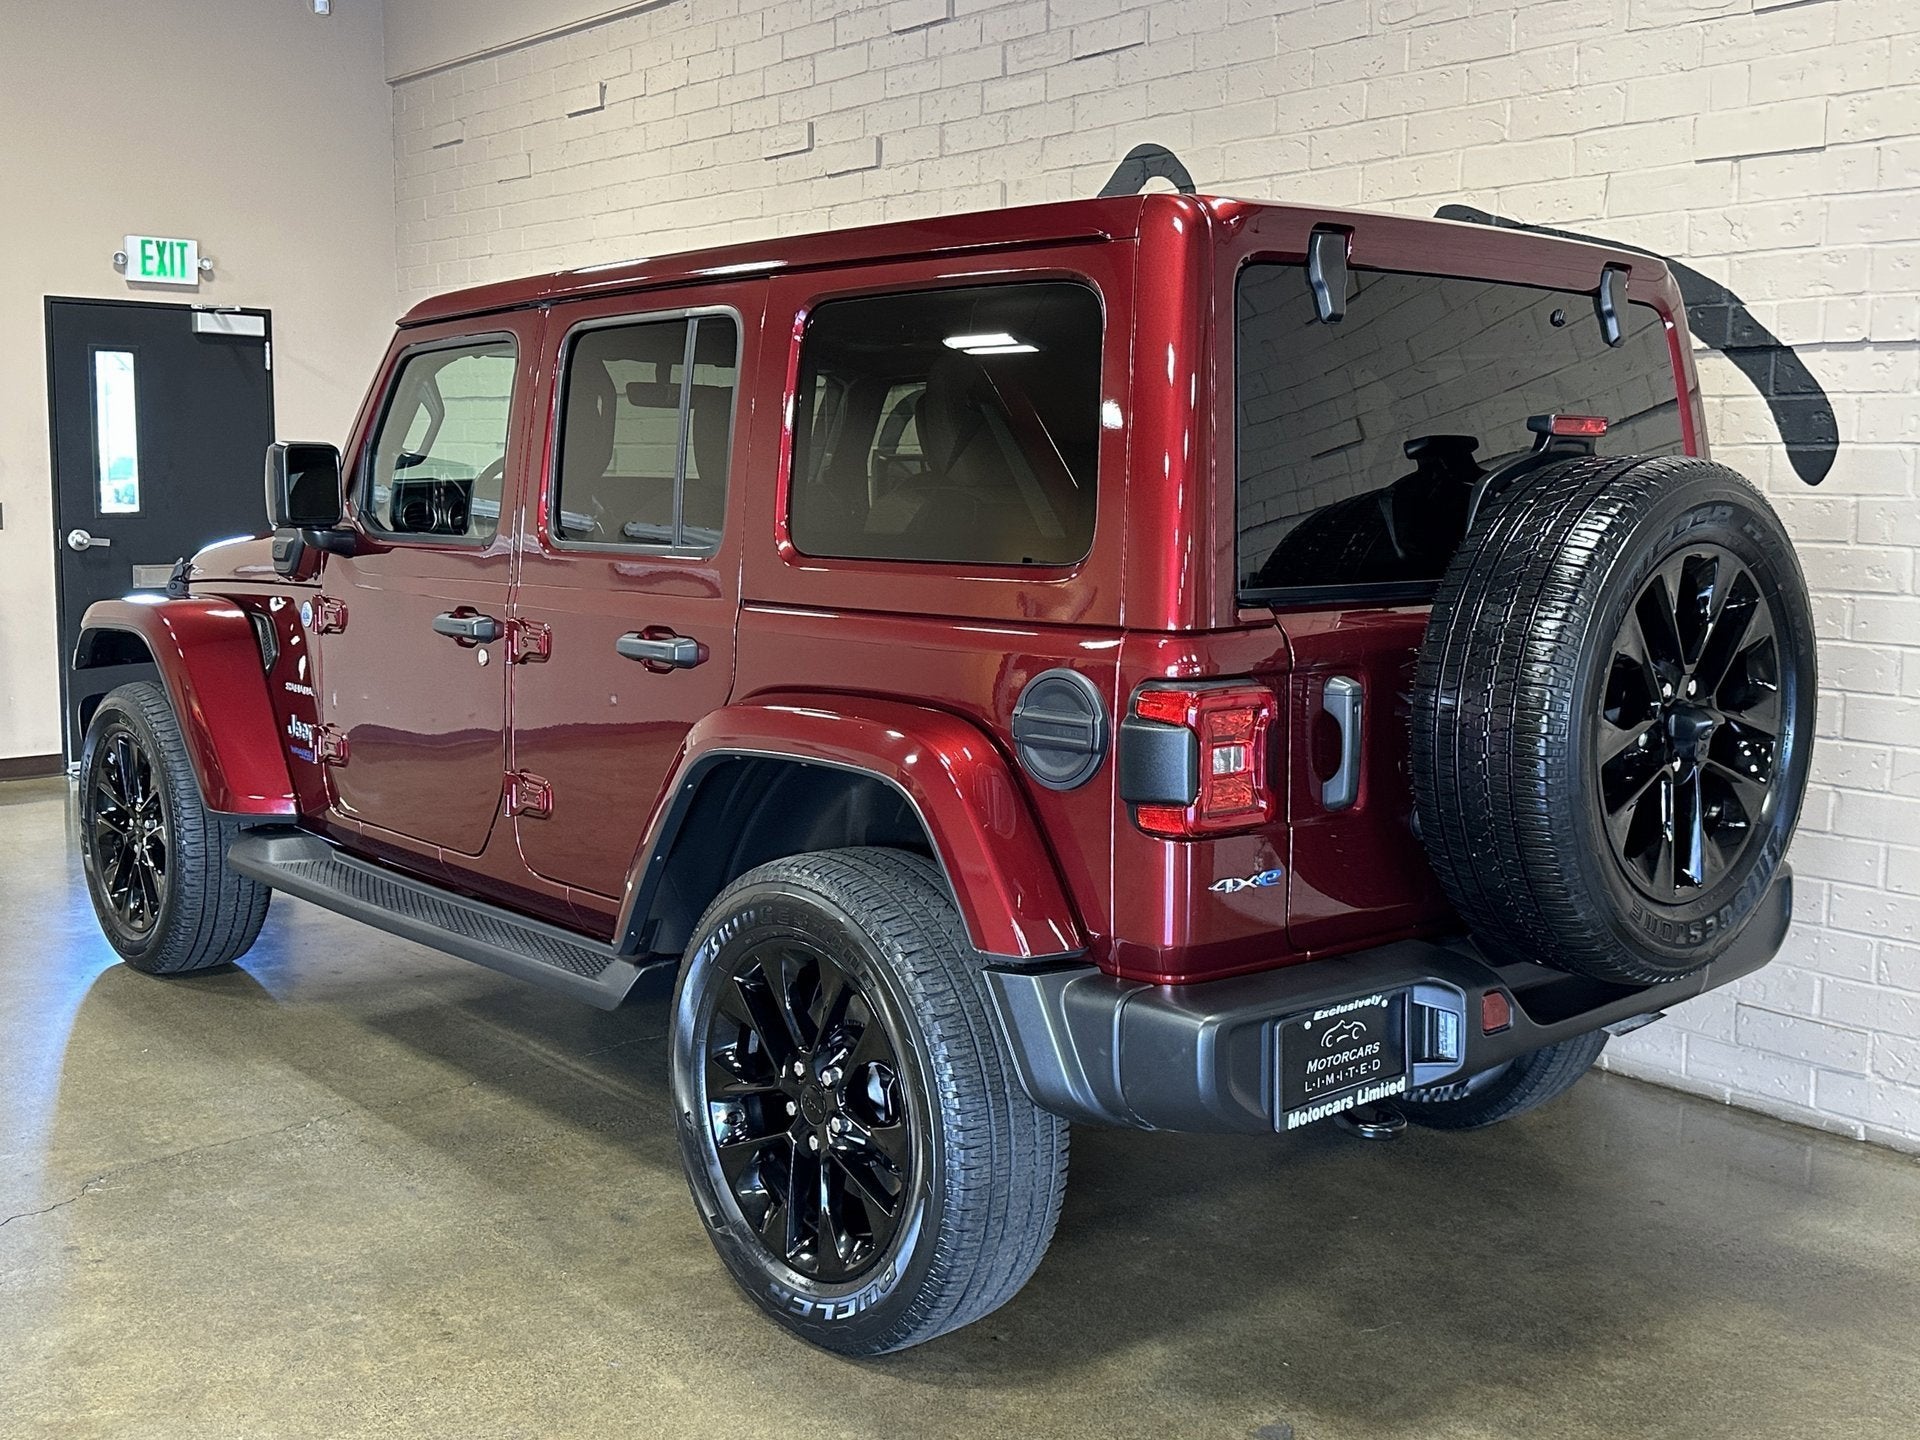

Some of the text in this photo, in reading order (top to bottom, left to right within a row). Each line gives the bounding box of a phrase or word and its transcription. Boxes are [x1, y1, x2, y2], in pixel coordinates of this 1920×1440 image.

[140, 239, 188, 278] EXIT
[1313, 994, 1383, 1021] Exclusively
[1306, 1041, 1381, 1075] MOTORCARS
[1287, 1076, 1406, 1130] Motorcars Limited
